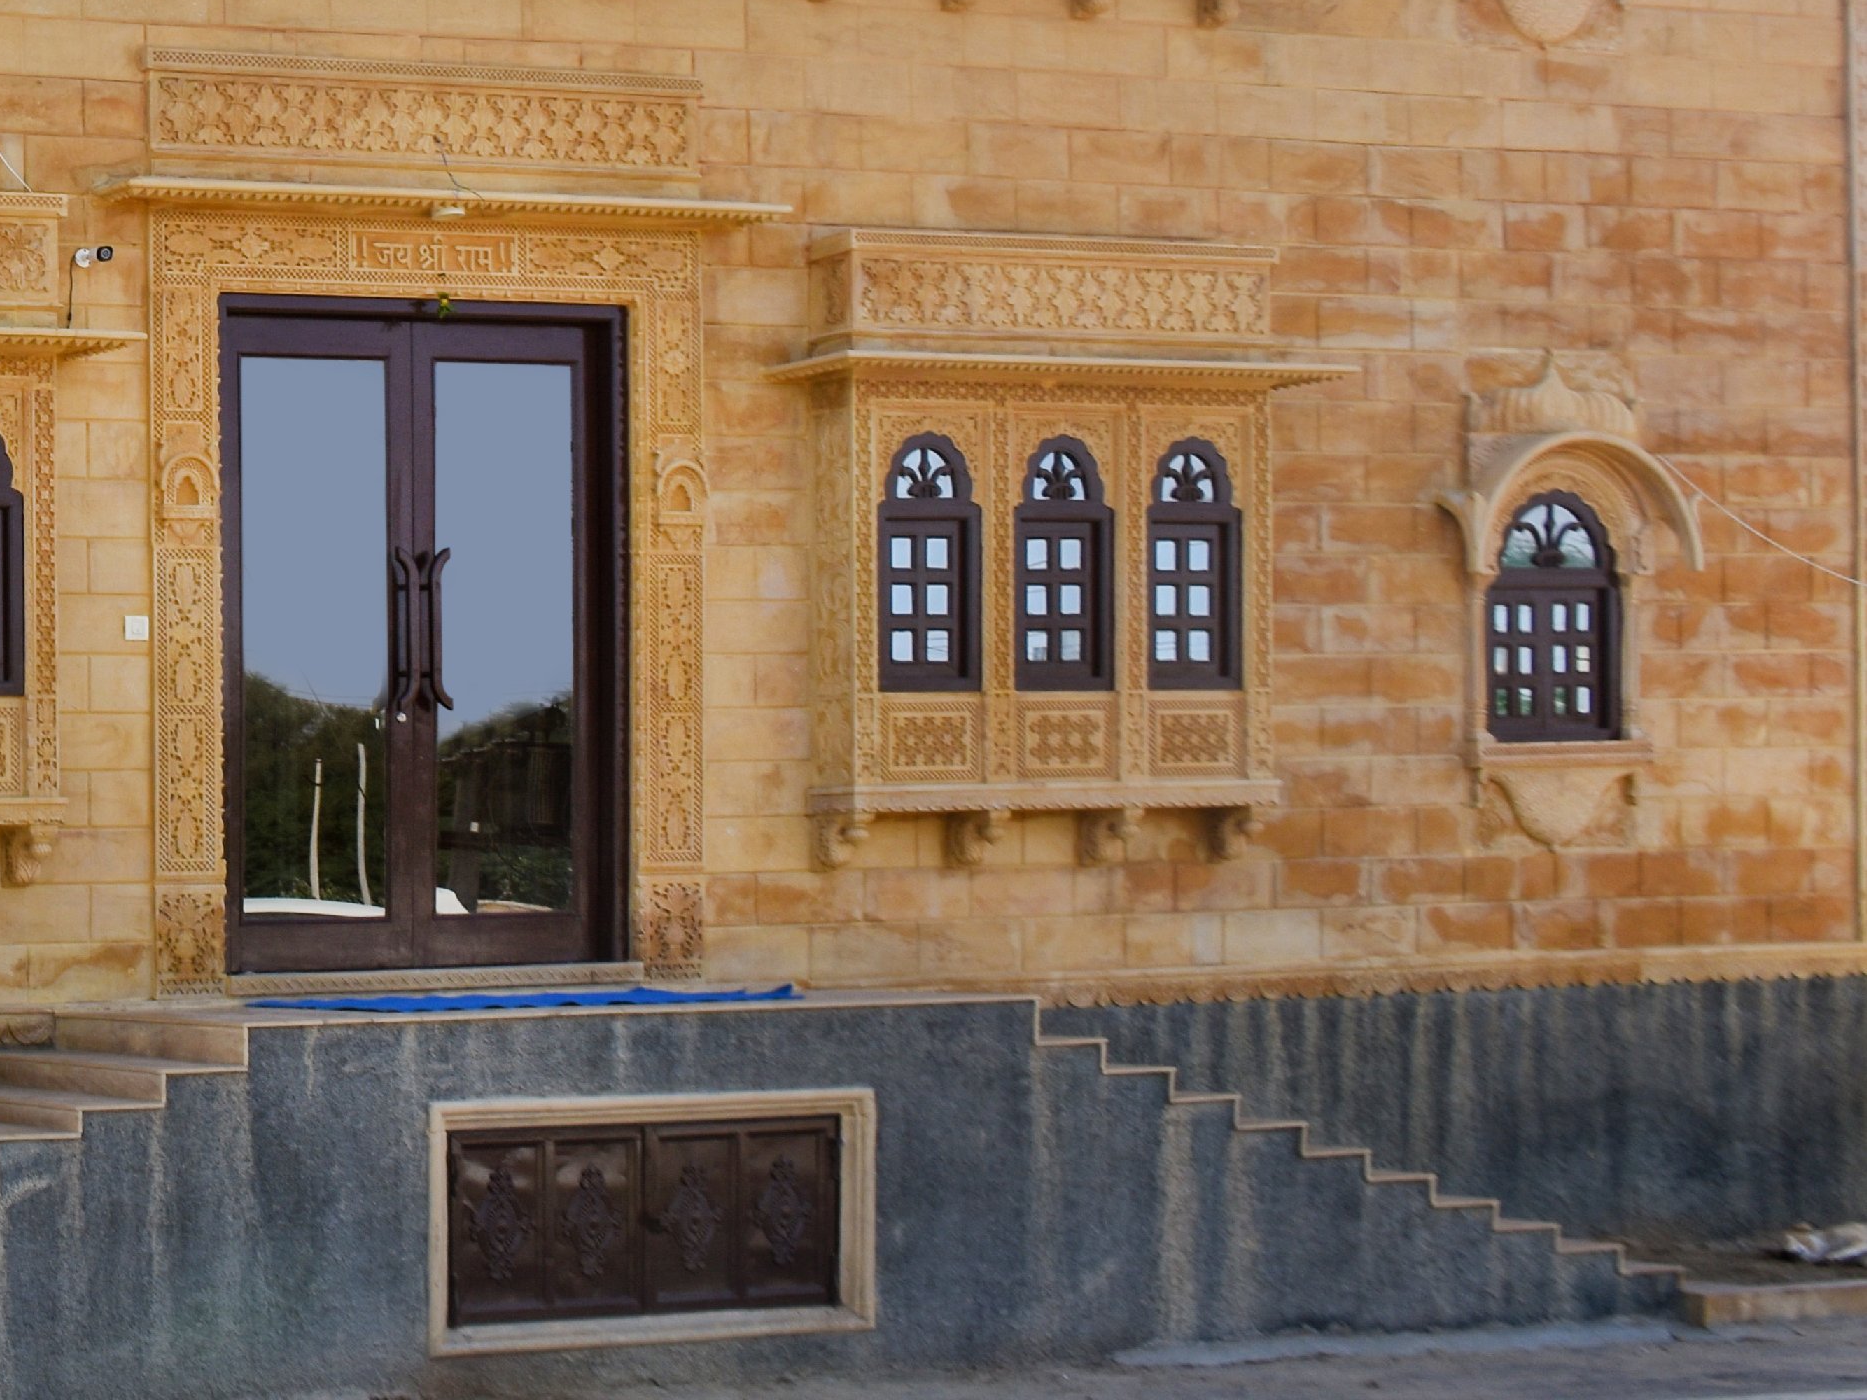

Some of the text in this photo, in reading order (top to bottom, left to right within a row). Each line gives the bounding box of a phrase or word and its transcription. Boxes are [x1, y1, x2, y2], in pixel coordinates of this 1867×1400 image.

[373, 242, 415, 270] जय
[419, 234, 448, 271] श्री
[455, 245, 494, 273] राम
